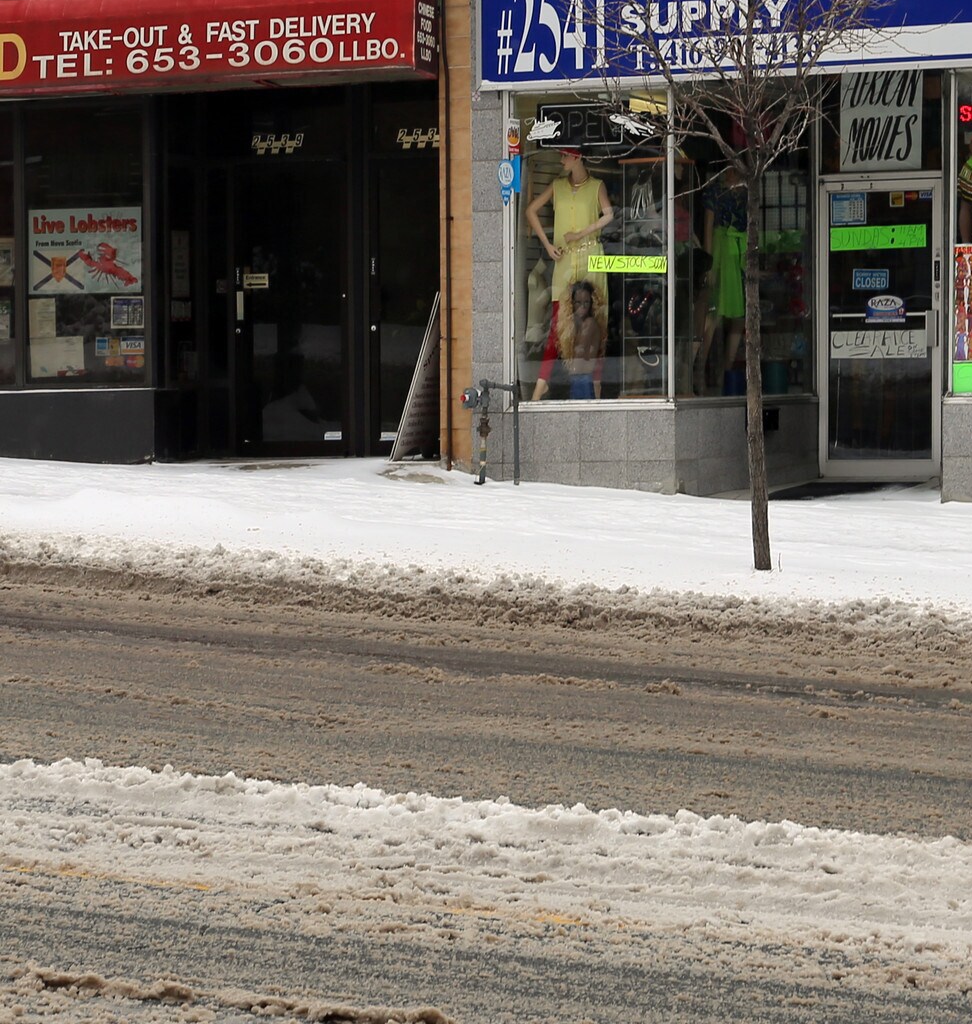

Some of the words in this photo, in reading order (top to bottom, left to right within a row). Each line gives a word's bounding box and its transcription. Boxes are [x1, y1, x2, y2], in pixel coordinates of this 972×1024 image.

[59, 25, 168, 52] TAKE-OUT
[178, 23, 192, 45] &
[206, 20, 260, 43] FAST
[269, 12, 376, 38] DELIVERY
[420, 18, 433, 33] FOOD
[33, 54, 114, 80] TEL:
[126, 37, 334, 74] 653-3060
[252, 133, 303, 148] 2539
[398, 128, 438, 143] 253
[842, 114, 918, 166] MOVIES
[33, 215, 66, 234] Live
[70, 213, 138, 233] Lobsters
[589, 256, 616, 270] NEW
[616, 255, 647, 269] STOCK
[855, 277, 887, 289] CLOSED
[871, 297, 897, 309] RAZA
